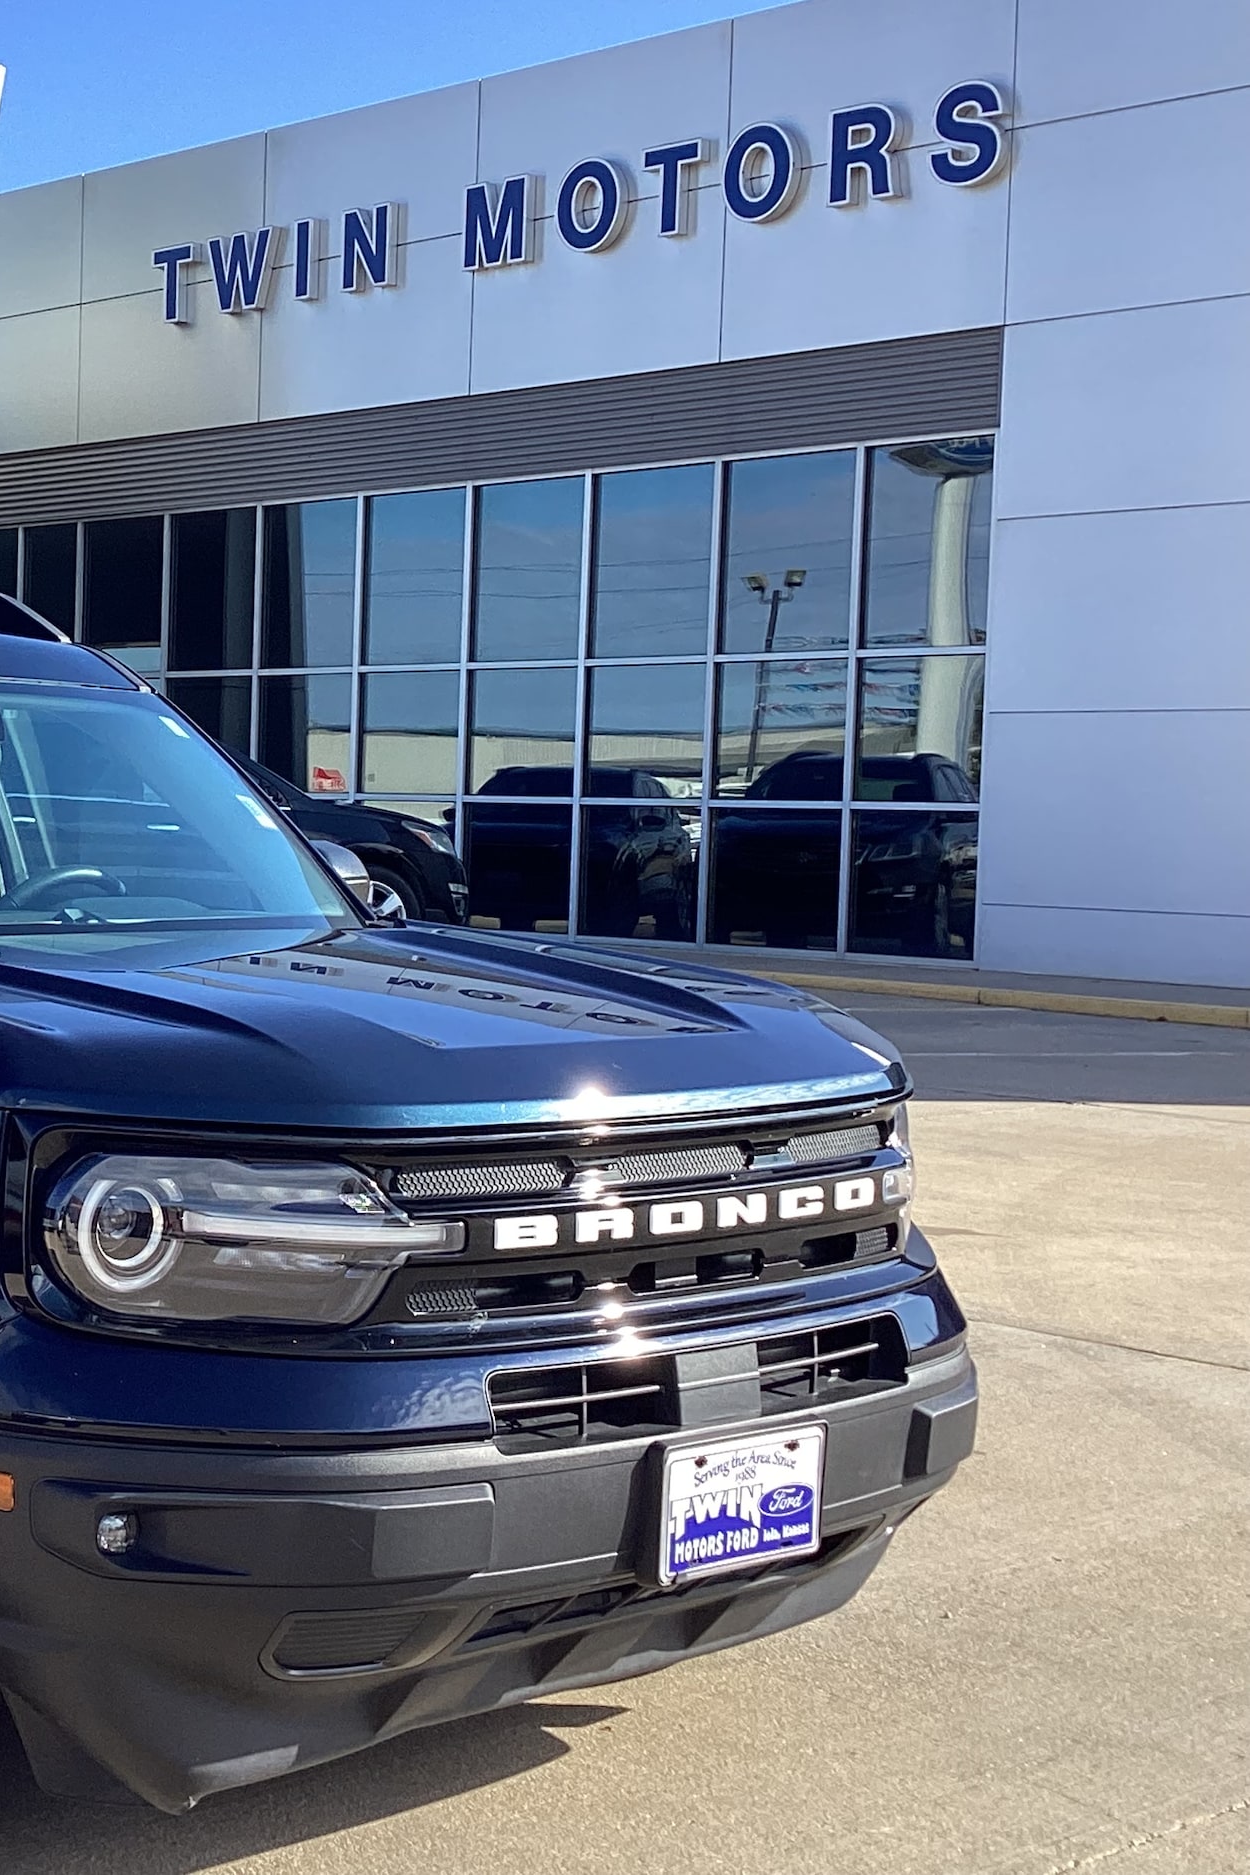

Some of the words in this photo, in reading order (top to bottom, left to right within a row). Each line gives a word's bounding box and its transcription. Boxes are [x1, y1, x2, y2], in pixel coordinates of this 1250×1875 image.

[152, 202, 397, 323] TWIN
[463, 79, 1007, 271] MOTORS
[493, 1177, 875, 1250] BRONCO
[694, 1460, 730, 1487] Serving
[731, 1450, 747, 1468] the
[748, 1450, 771, 1465] Area
[670, 1483, 763, 1540] TWIN
[769, 1487, 803, 1512] Ford
[674, 1532, 724, 1564] MOTORS
[726, 1526, 759, 1553] FORD
